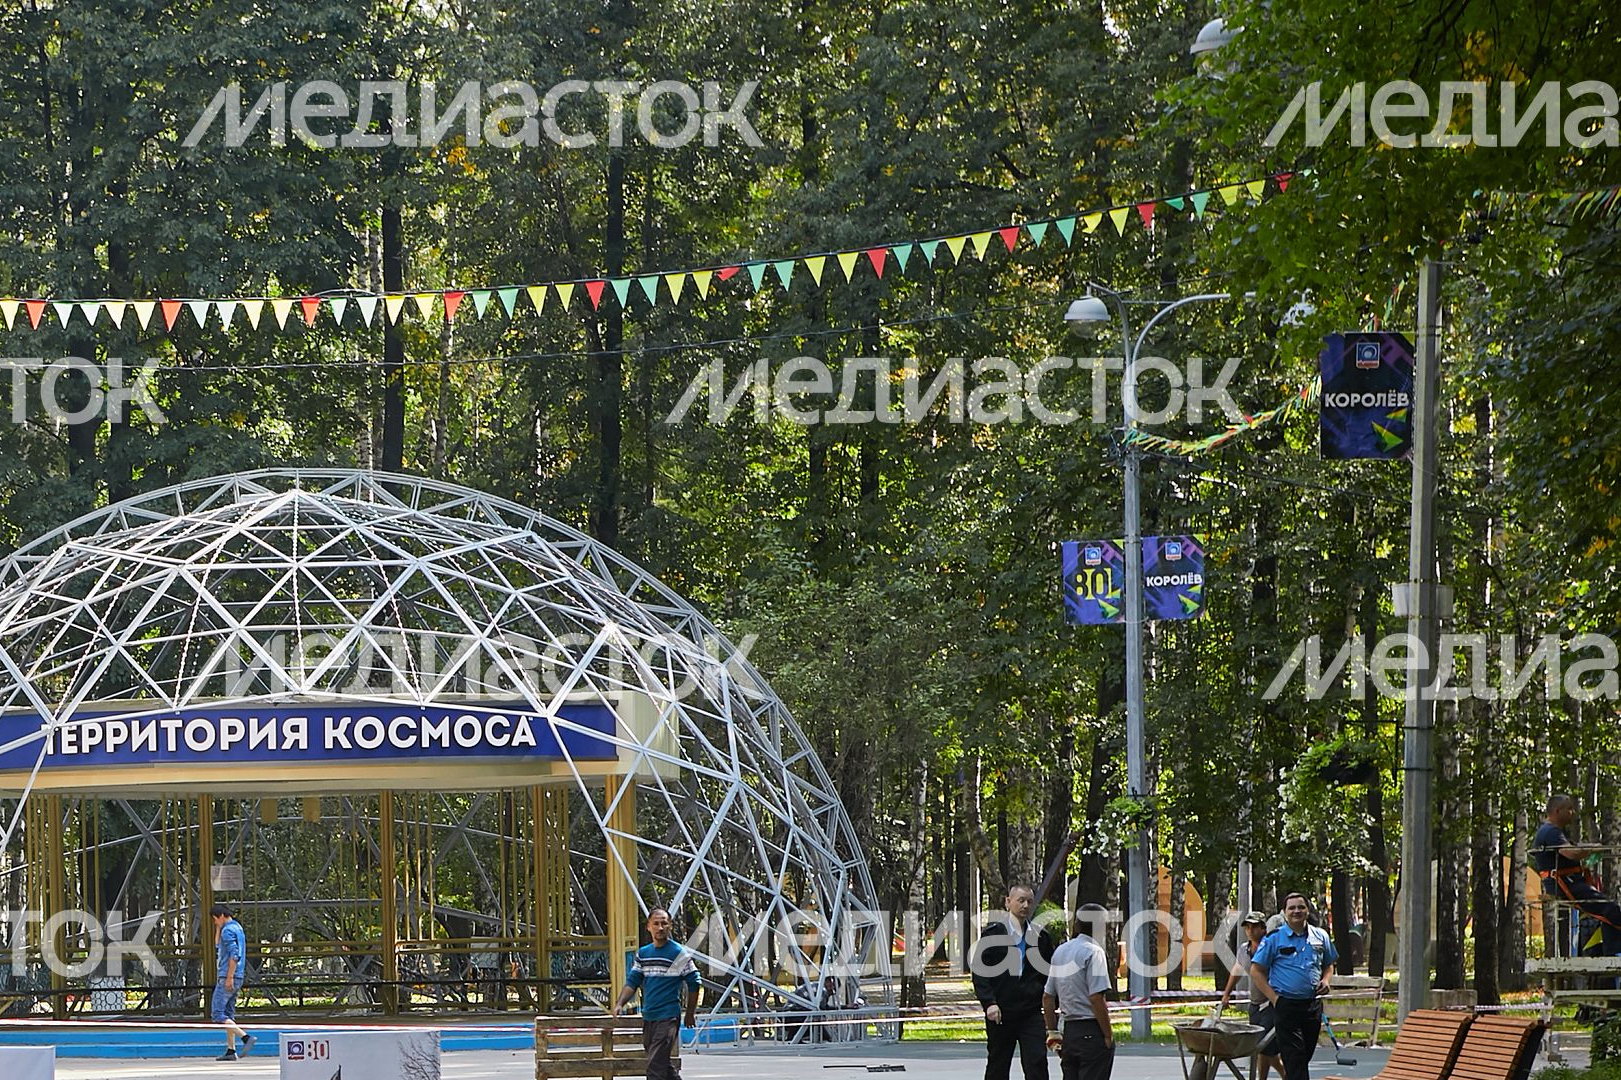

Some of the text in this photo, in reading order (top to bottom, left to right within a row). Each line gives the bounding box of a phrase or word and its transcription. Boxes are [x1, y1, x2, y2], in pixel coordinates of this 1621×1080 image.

[1325, 389, 1409, 407] КОРОЛЁВ
[1075, 567, 1112, 600] 80
[1146, 572, 1202, 587] КОРОЛЁВ
[324, 714, 537, 750] КОСМОСА
